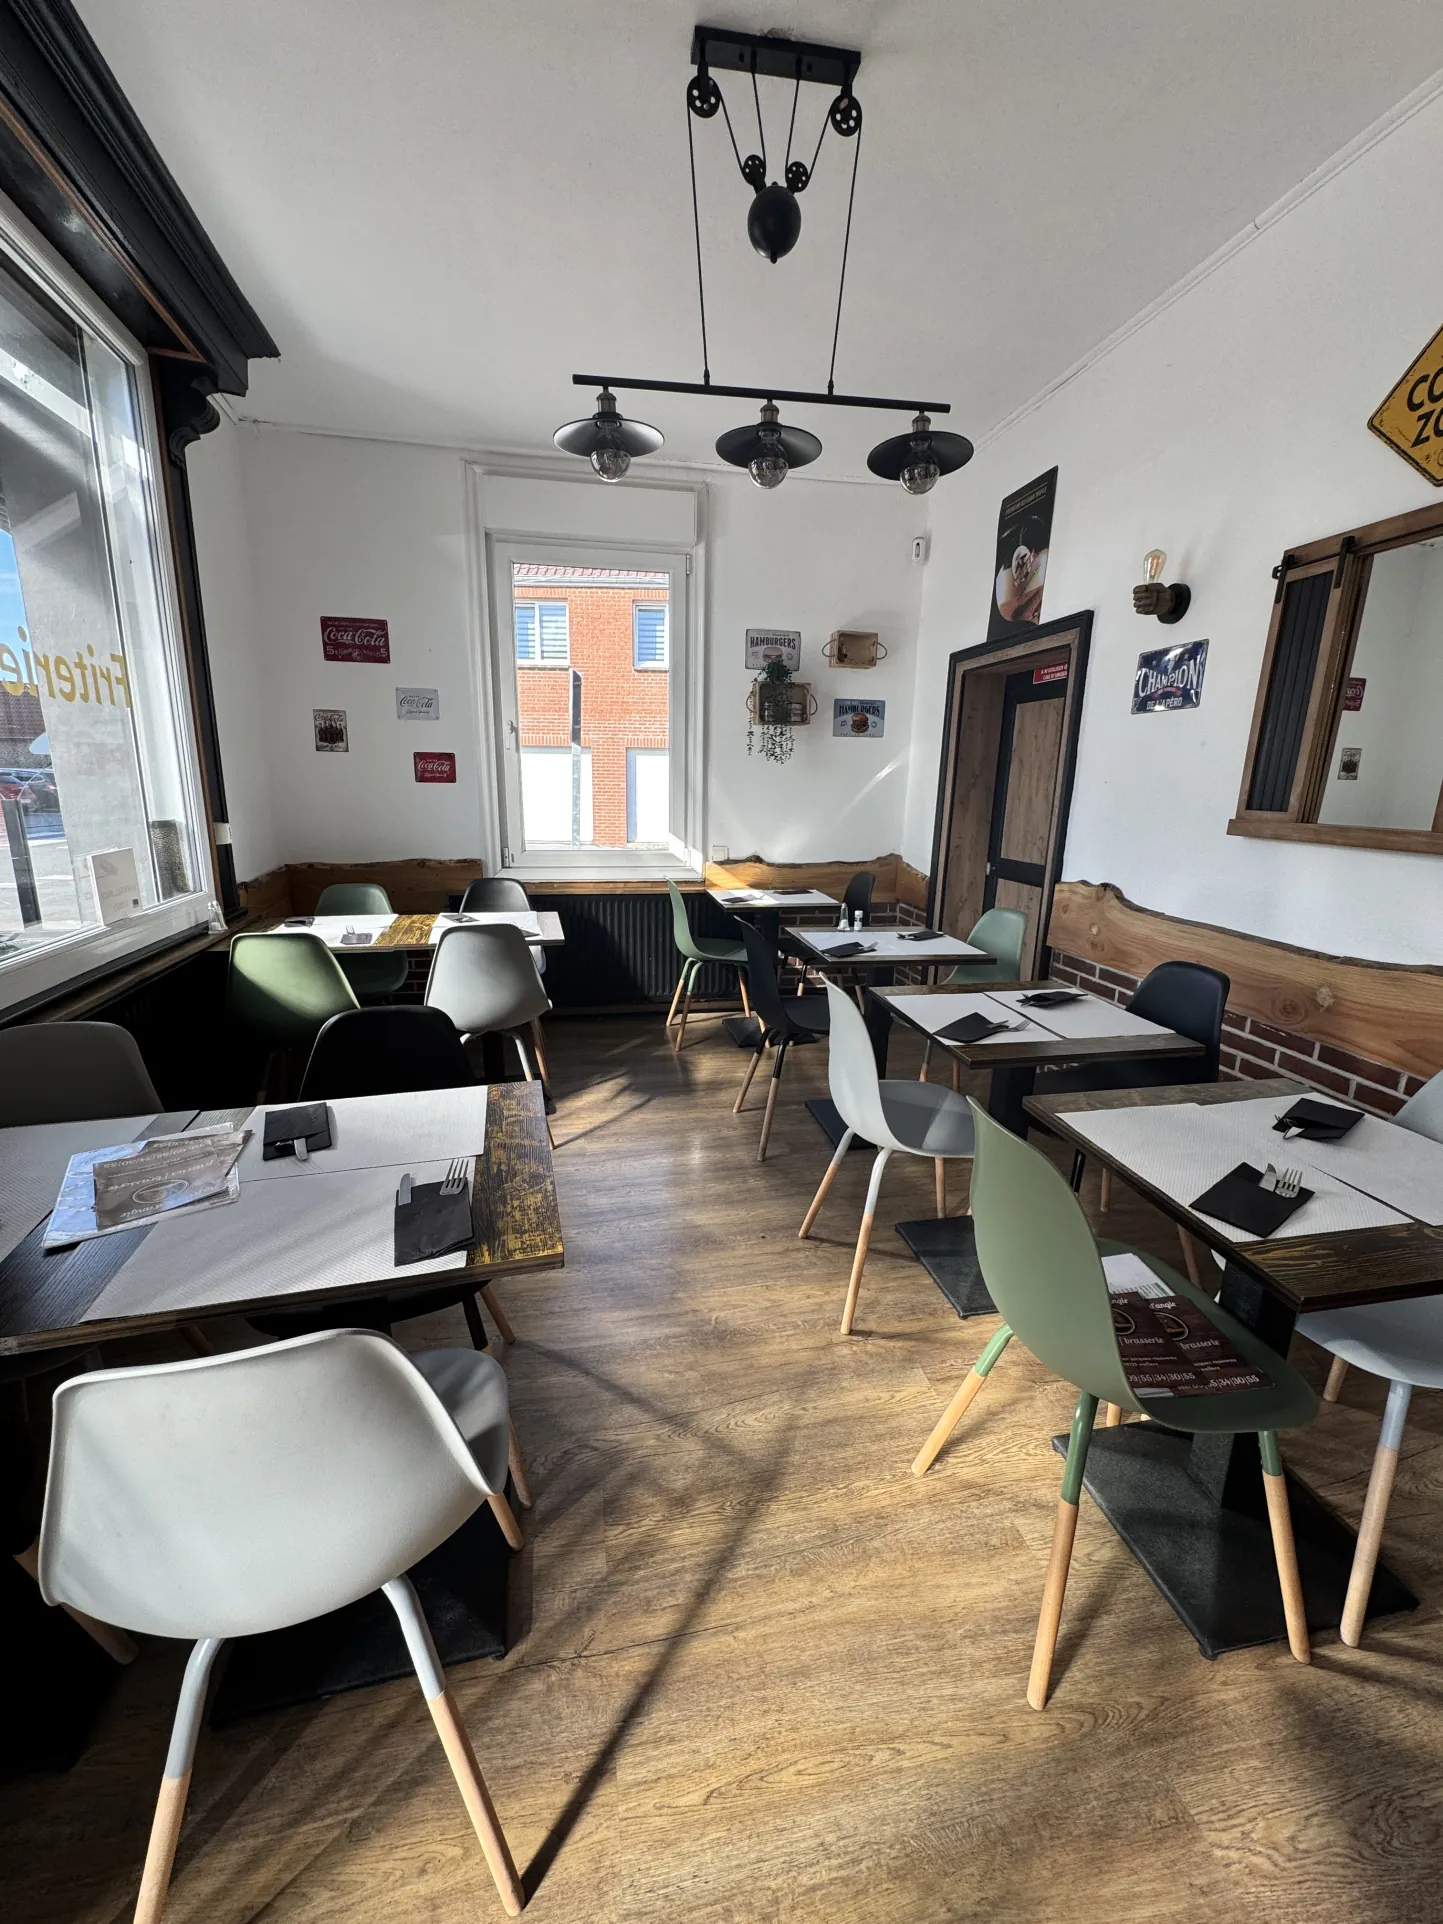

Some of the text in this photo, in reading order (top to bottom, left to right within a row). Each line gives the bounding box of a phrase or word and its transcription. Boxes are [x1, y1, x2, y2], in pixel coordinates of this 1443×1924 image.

[750, 636, 797, 650] HAMBURGERS
[1138, 655, 1201, 698] CHAMPION
[1111, 1297, 1129, 1306] ngle
[1123, 1336, 1165, 1345] brasserie
[1179, 1338, 1221, 1350] brasserie
